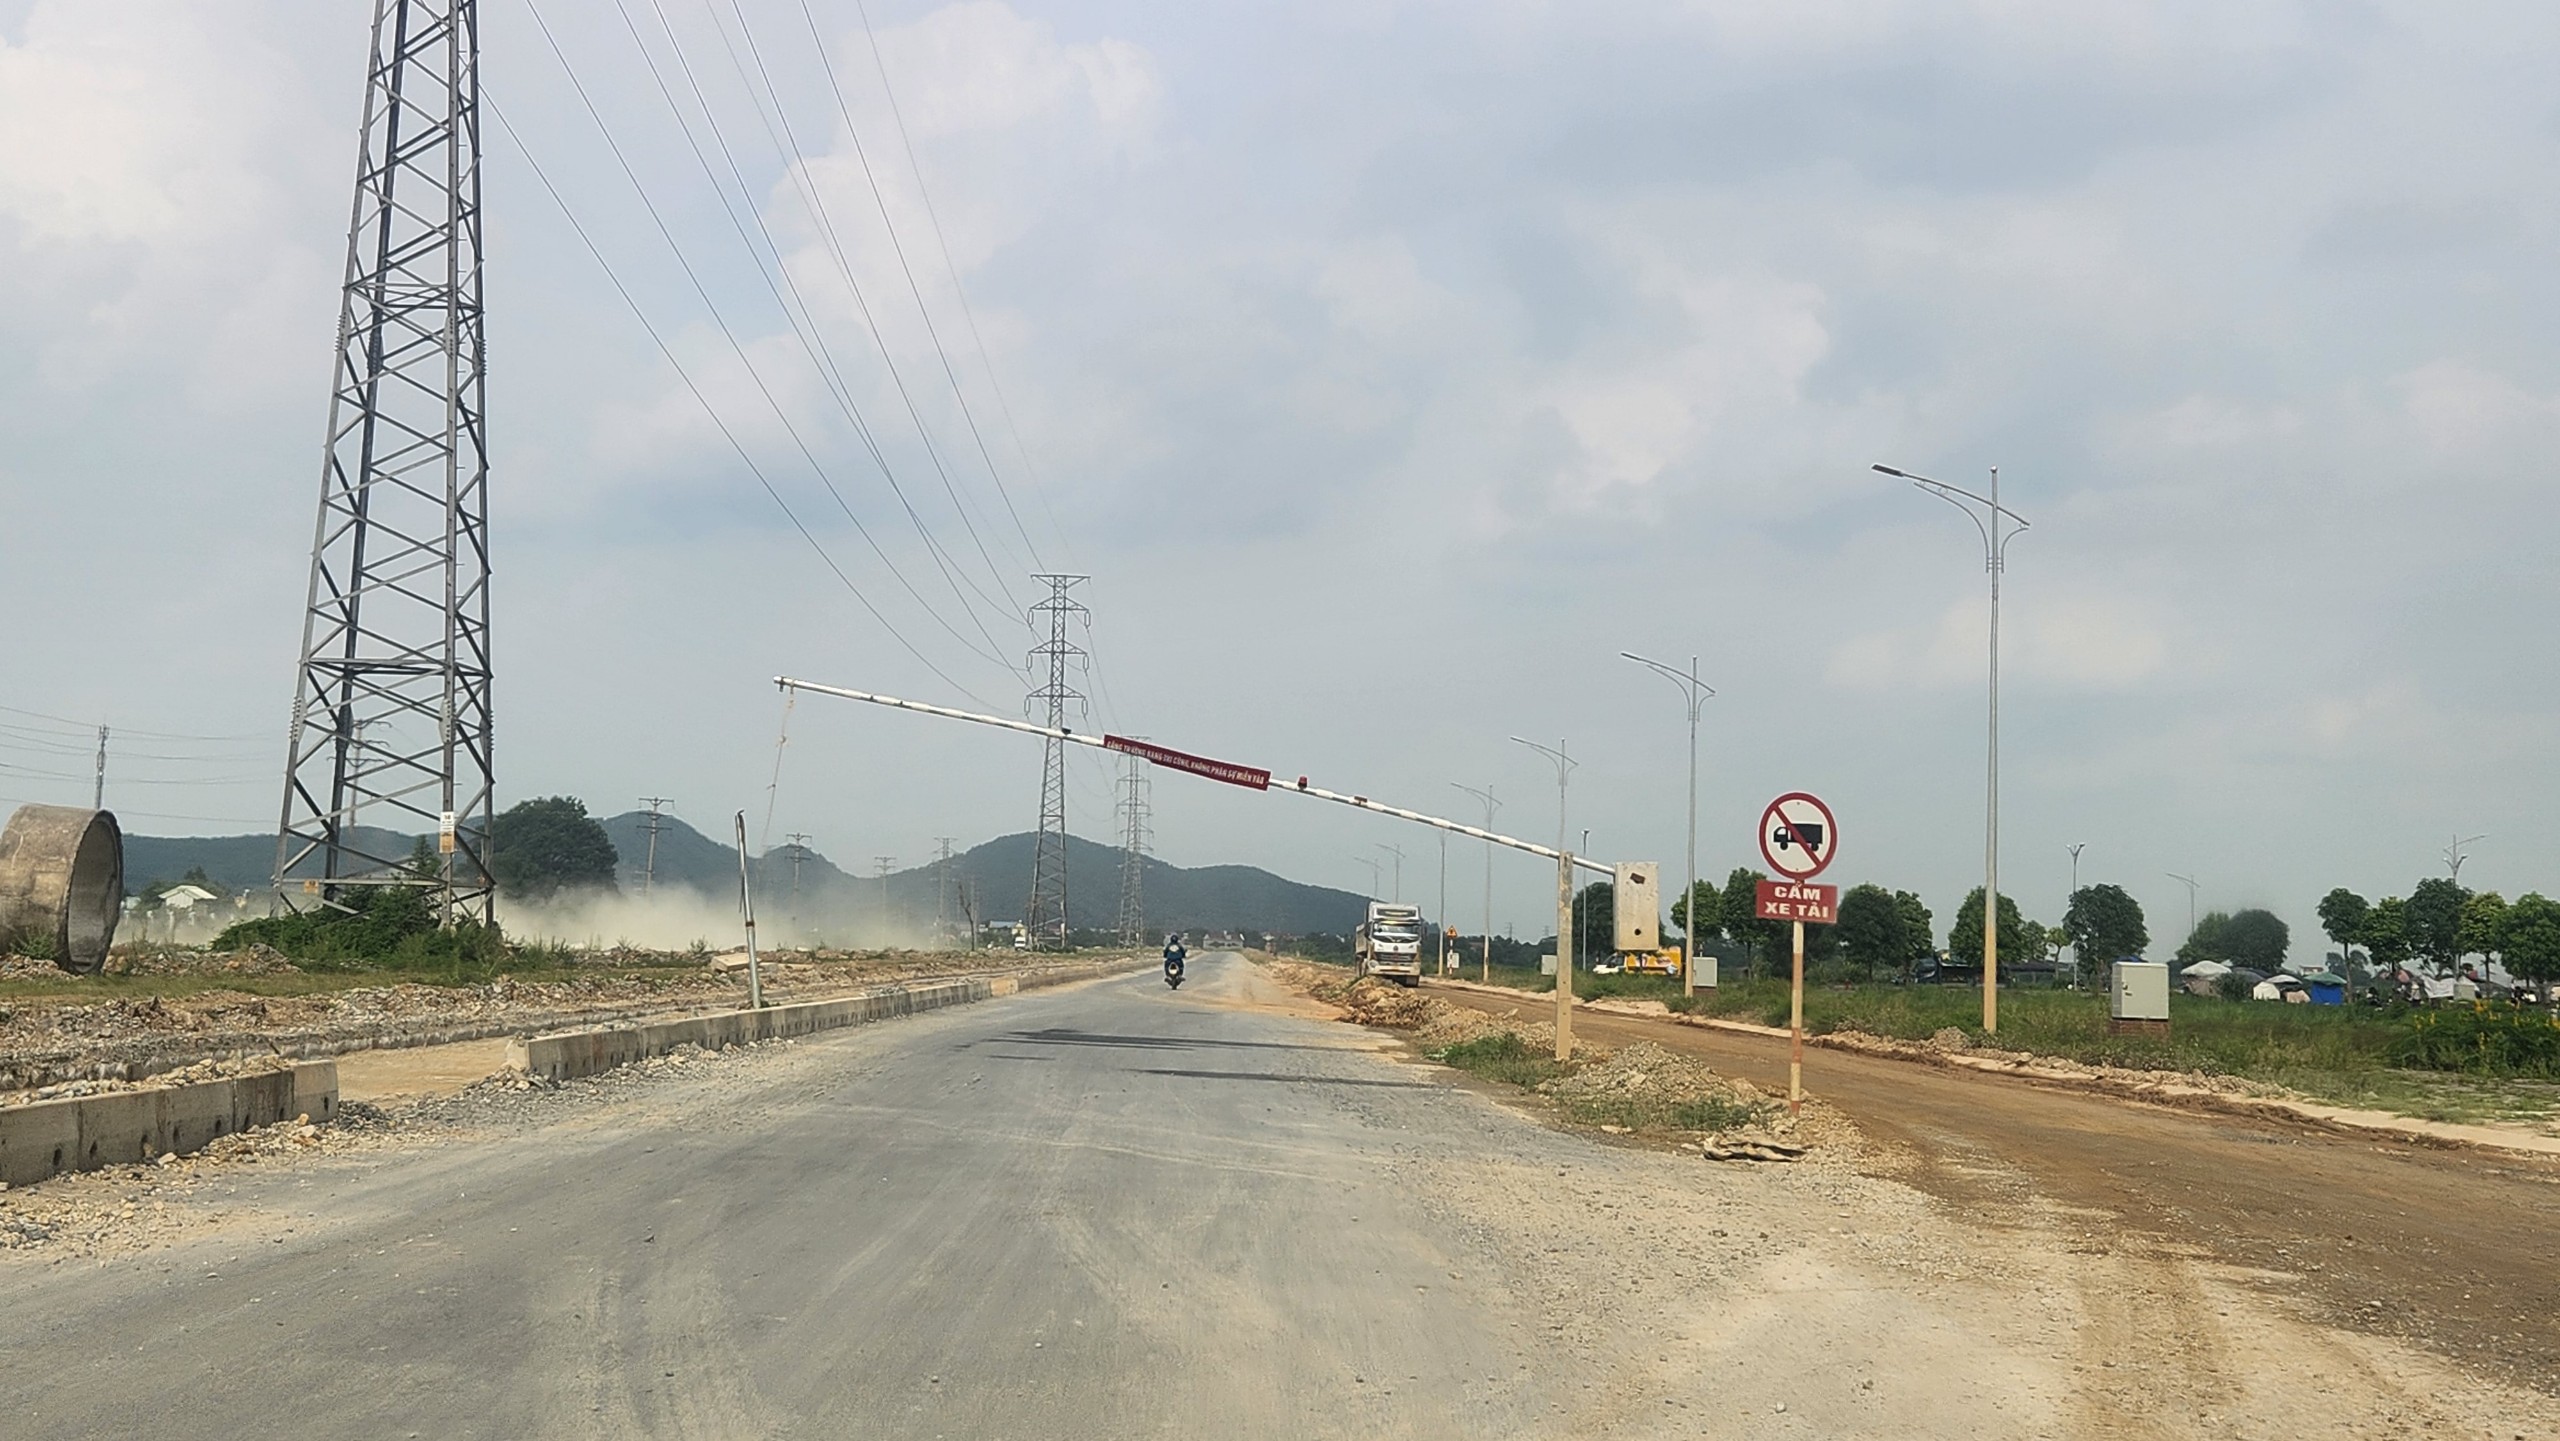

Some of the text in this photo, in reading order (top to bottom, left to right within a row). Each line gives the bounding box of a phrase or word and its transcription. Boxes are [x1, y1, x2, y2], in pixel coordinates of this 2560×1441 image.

[1774, 881, 1821, 901] CẤM
[1764, 901, 1829, 918] XE TẢI
